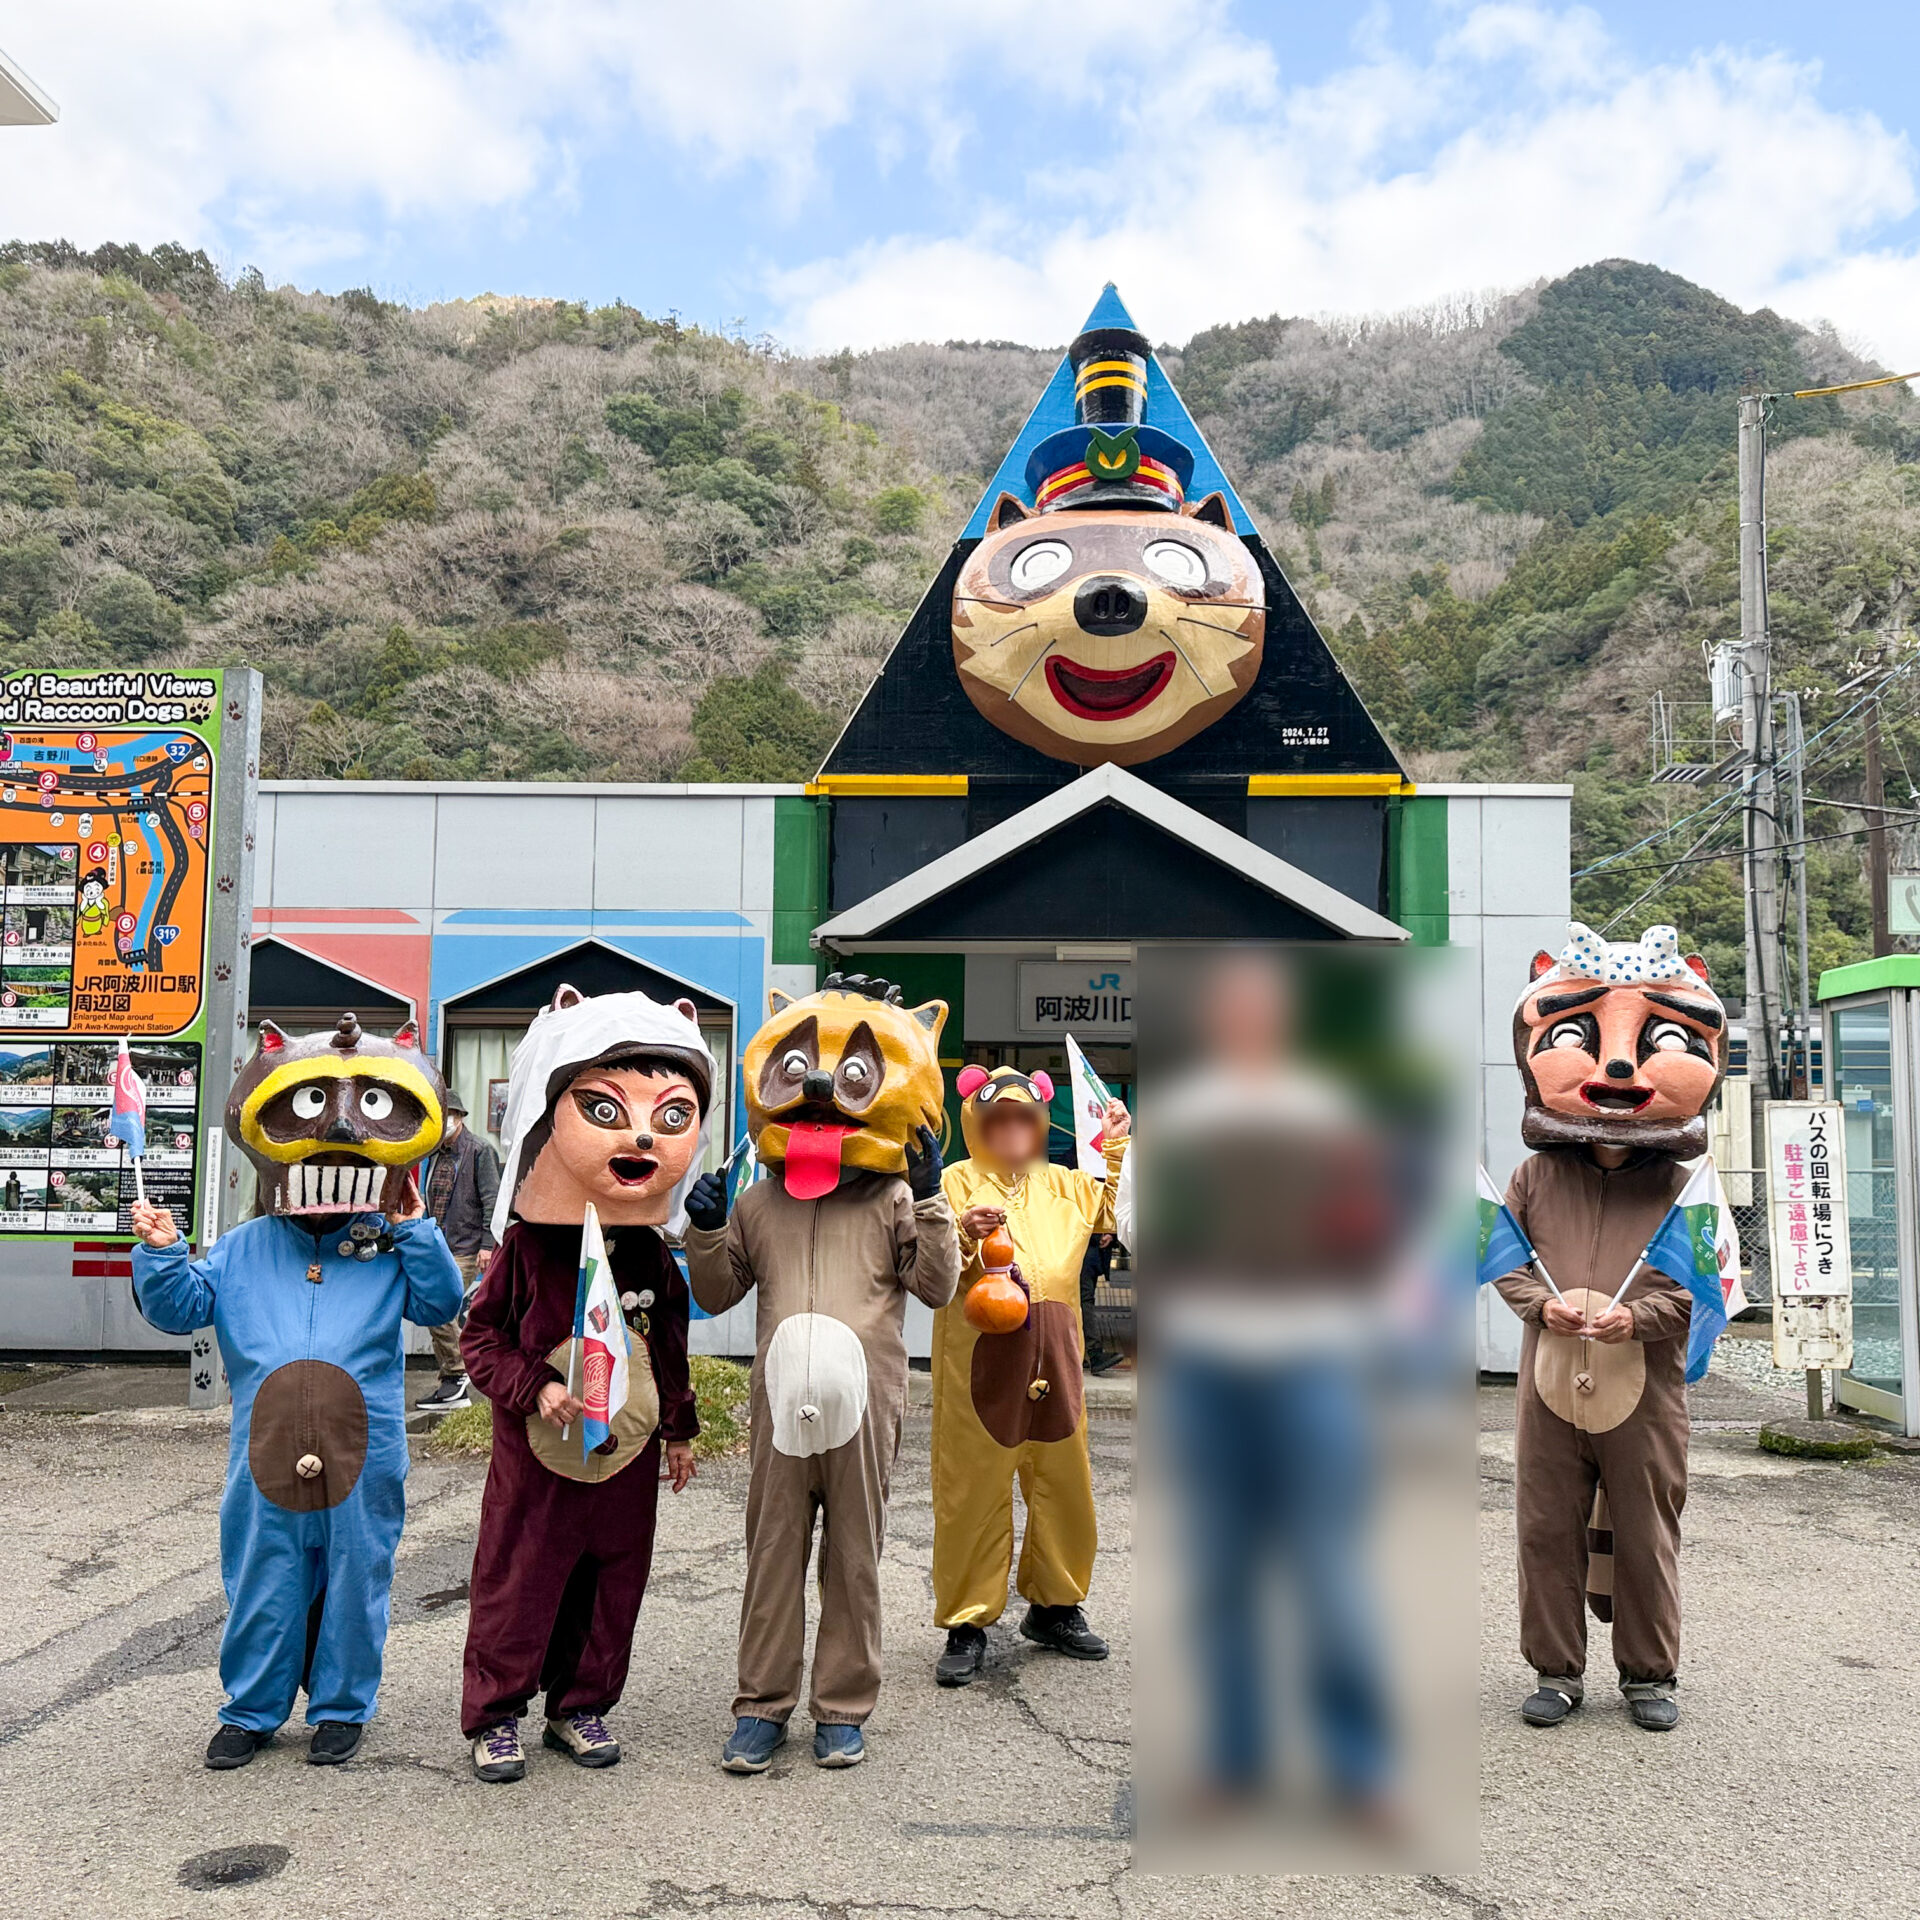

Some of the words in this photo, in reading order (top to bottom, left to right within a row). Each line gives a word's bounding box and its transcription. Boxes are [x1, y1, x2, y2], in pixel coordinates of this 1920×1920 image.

[8, 675, 34, 696] of
[40, 675, 143, 696] Beautiful
[149, 675, 214, 696] Views
[25, 700, 121, 720] Raccoon
[127, 700, 185, 722] Dogs
[34, 750, 70, 761] 吉野川
[170, 745, 186, 756] 32
[158, 928, 177, 940] 319
[75, 974, 197, 993] JR阿波川口駅
[1089, 973, 1121, 991] JR
[74, 994, 131, 1012] 周辺図
[73, 1013, 107, 1021] Enlarged
[109, 1013, 125, 1022] Map
[127, 1013, 154, 1021] around
[85, 1023, 145, 1032] Awa-Kawaguchi
[147, 1023, 174, 1031] Station
[1807, 1110, 1834, 1275] バスの回転場につき
[1784, 1142, 1811, 1291] 駐車ご遠慮下さい
